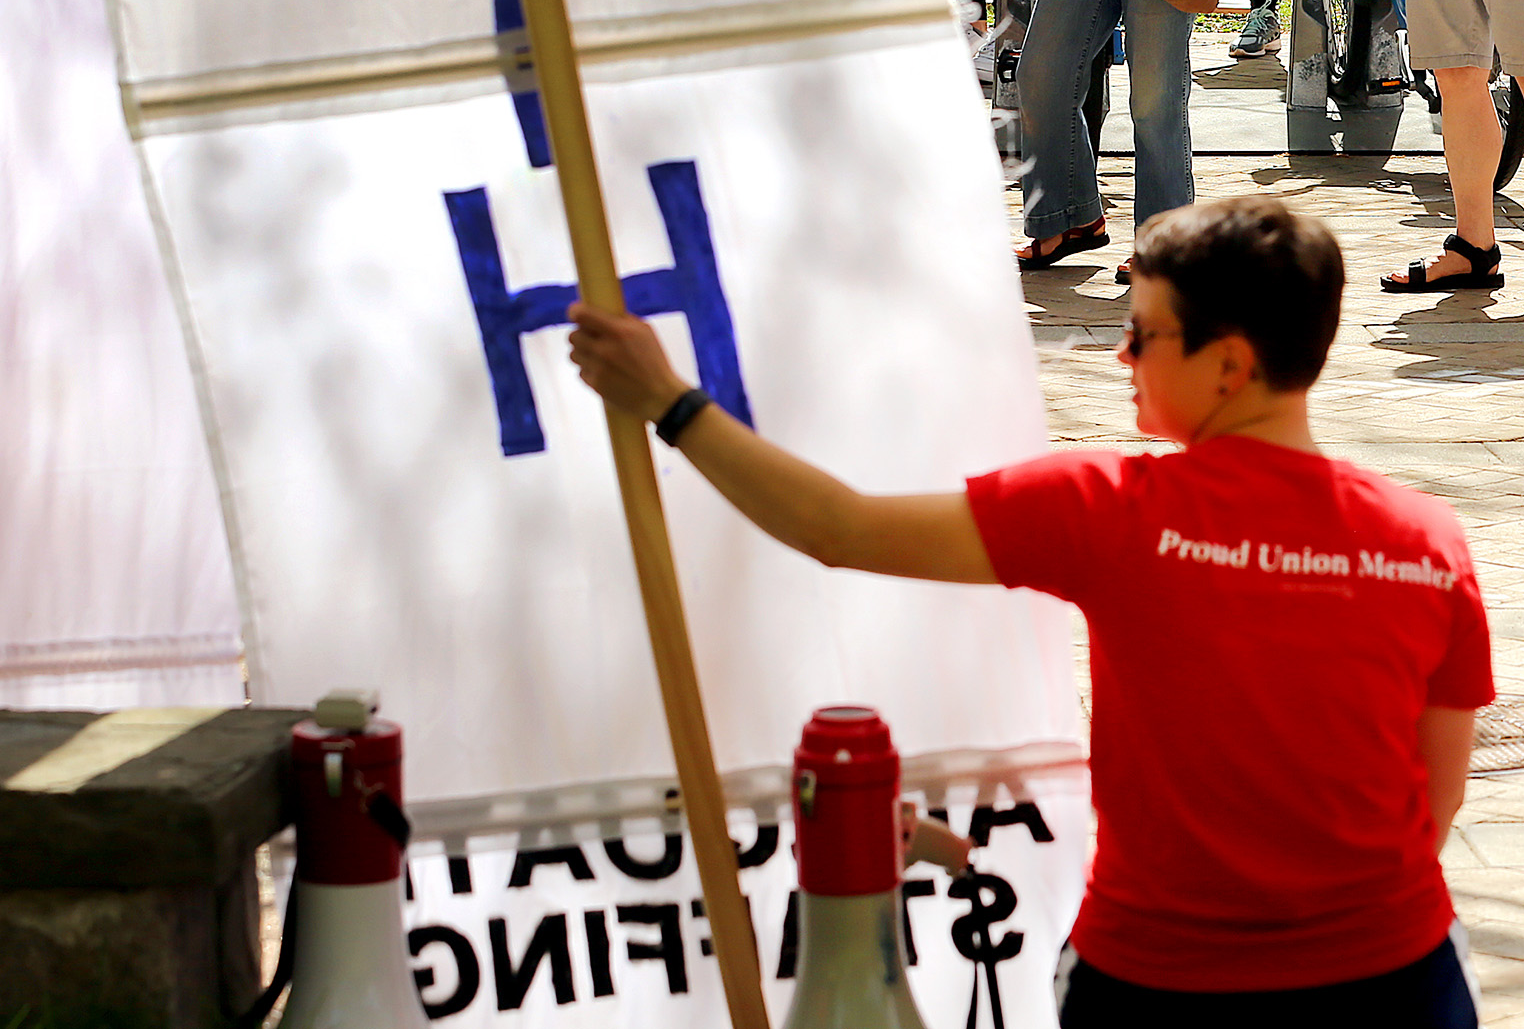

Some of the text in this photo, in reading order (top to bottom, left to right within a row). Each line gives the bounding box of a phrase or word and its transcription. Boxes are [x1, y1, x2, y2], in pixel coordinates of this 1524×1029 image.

[1157, 527, 1250, 569] Proud
[1258, 543, 1350, 577] Union
[1358, 549, 1459, 591] Member
